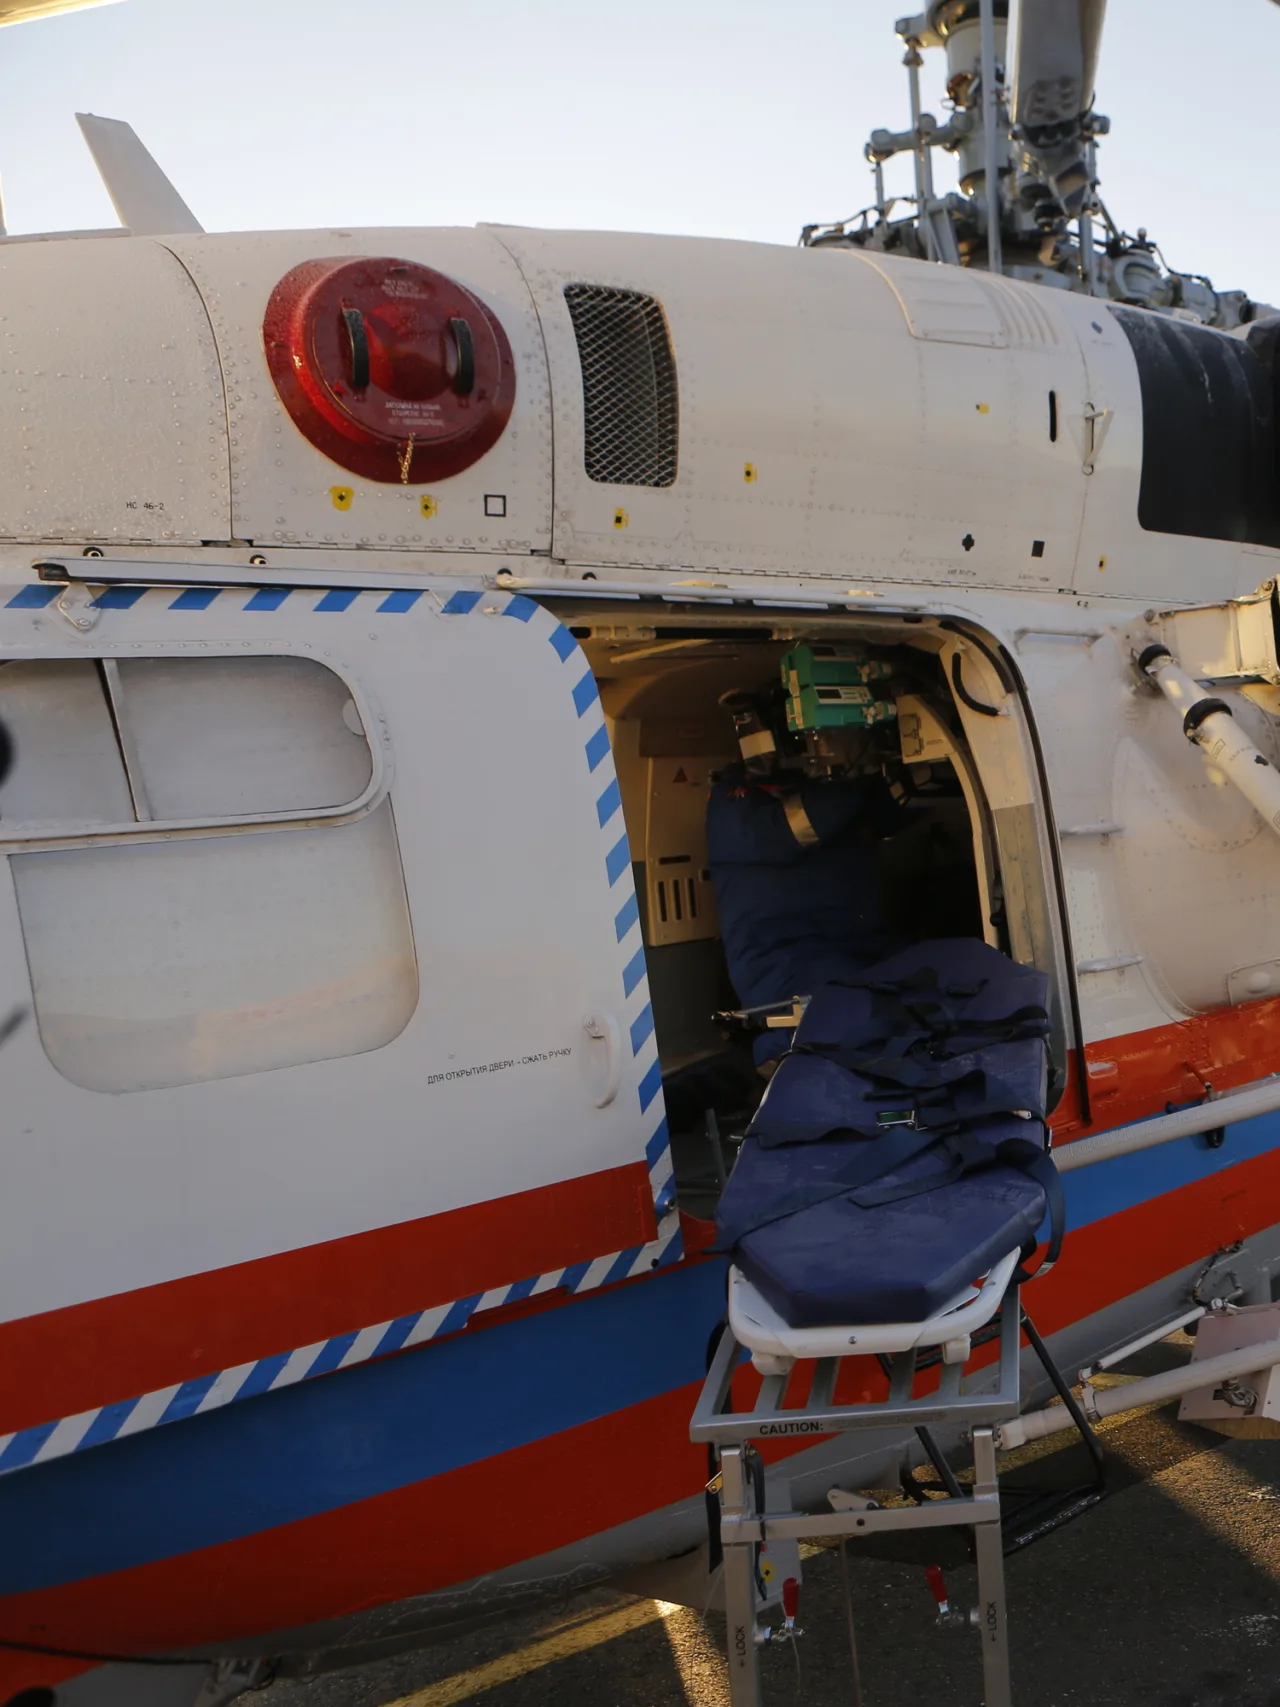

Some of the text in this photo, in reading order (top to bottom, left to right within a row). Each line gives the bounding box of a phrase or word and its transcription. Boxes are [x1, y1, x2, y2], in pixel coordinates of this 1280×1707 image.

[427, 1073, 445, 1085] ДЛЯ
[445, 1064, 488, 1081] ОТКРЫТИЯ
[488, 1060, 515, 1073] ДВЕРИ
[521, 1053, 548, 1065] СЖАТЬ
[548, 1047, 572, 1059] РУЧКУ
[759, 1421, 824, 1436] CAUTION:
[986, 1600, 997, 1631] LOCK
[735, 1624, 747, 1656] LOCK
